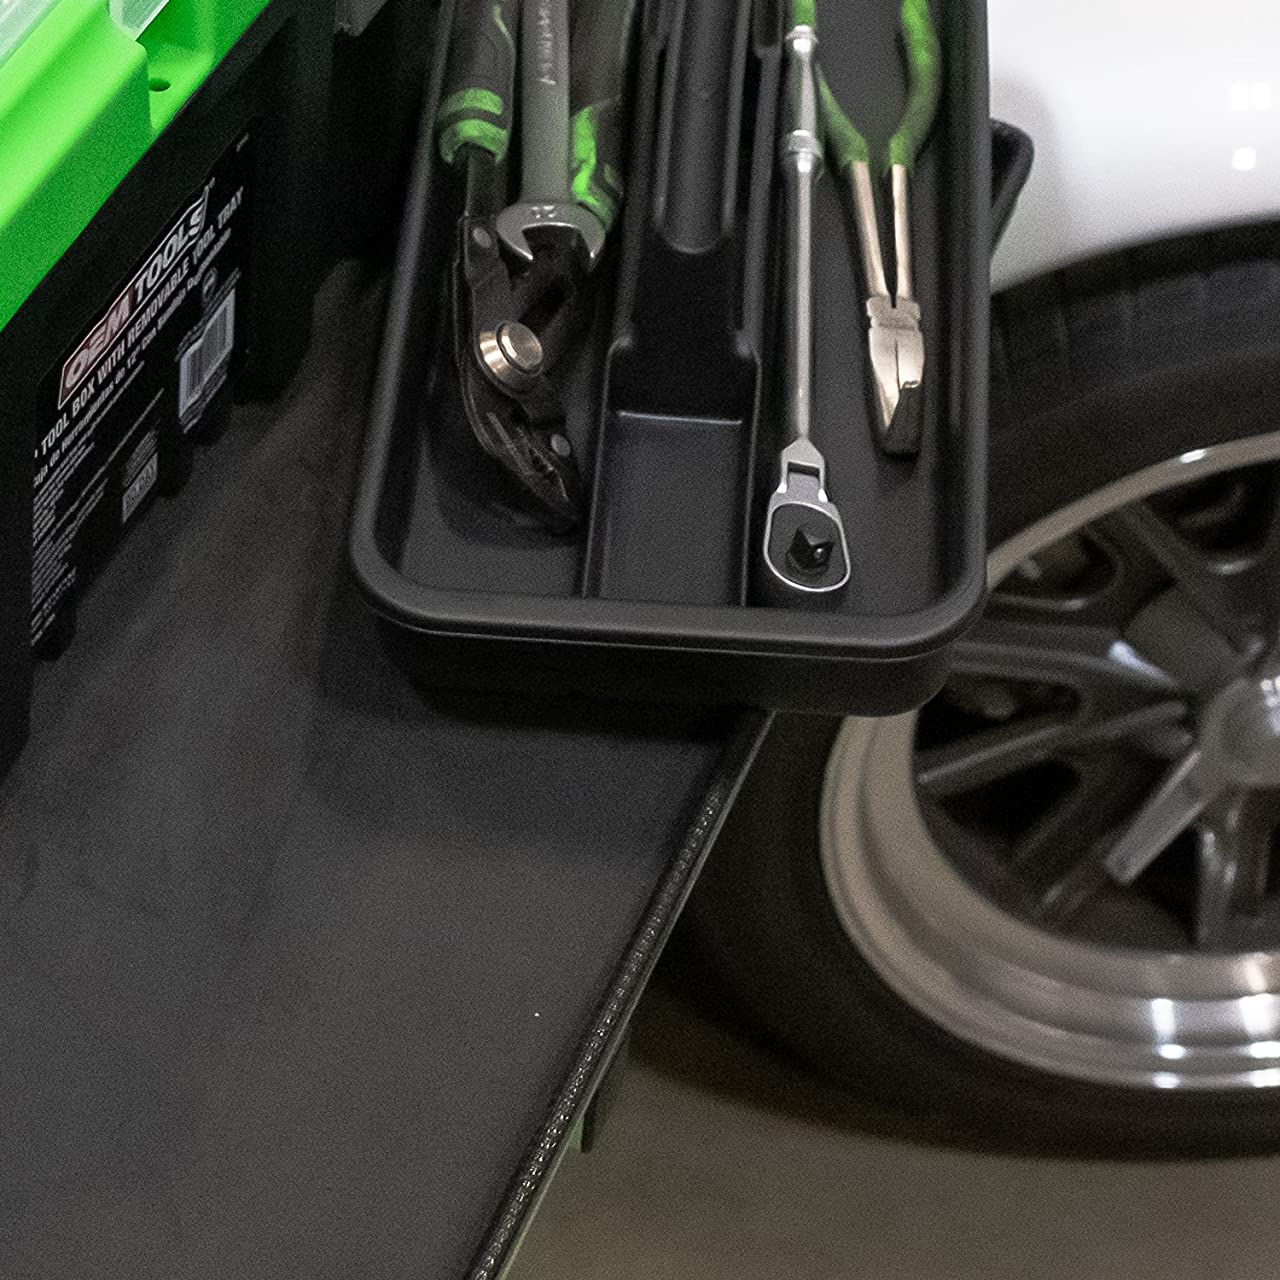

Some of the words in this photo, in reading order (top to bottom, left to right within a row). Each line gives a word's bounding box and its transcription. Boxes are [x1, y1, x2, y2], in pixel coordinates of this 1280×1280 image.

[41, 412, 70, 455] TOOL
[72, 375, 95, 418] BOX
[97, 338, 125, 385] WITH
[127, 256, 190, 348] REMOVABLE
